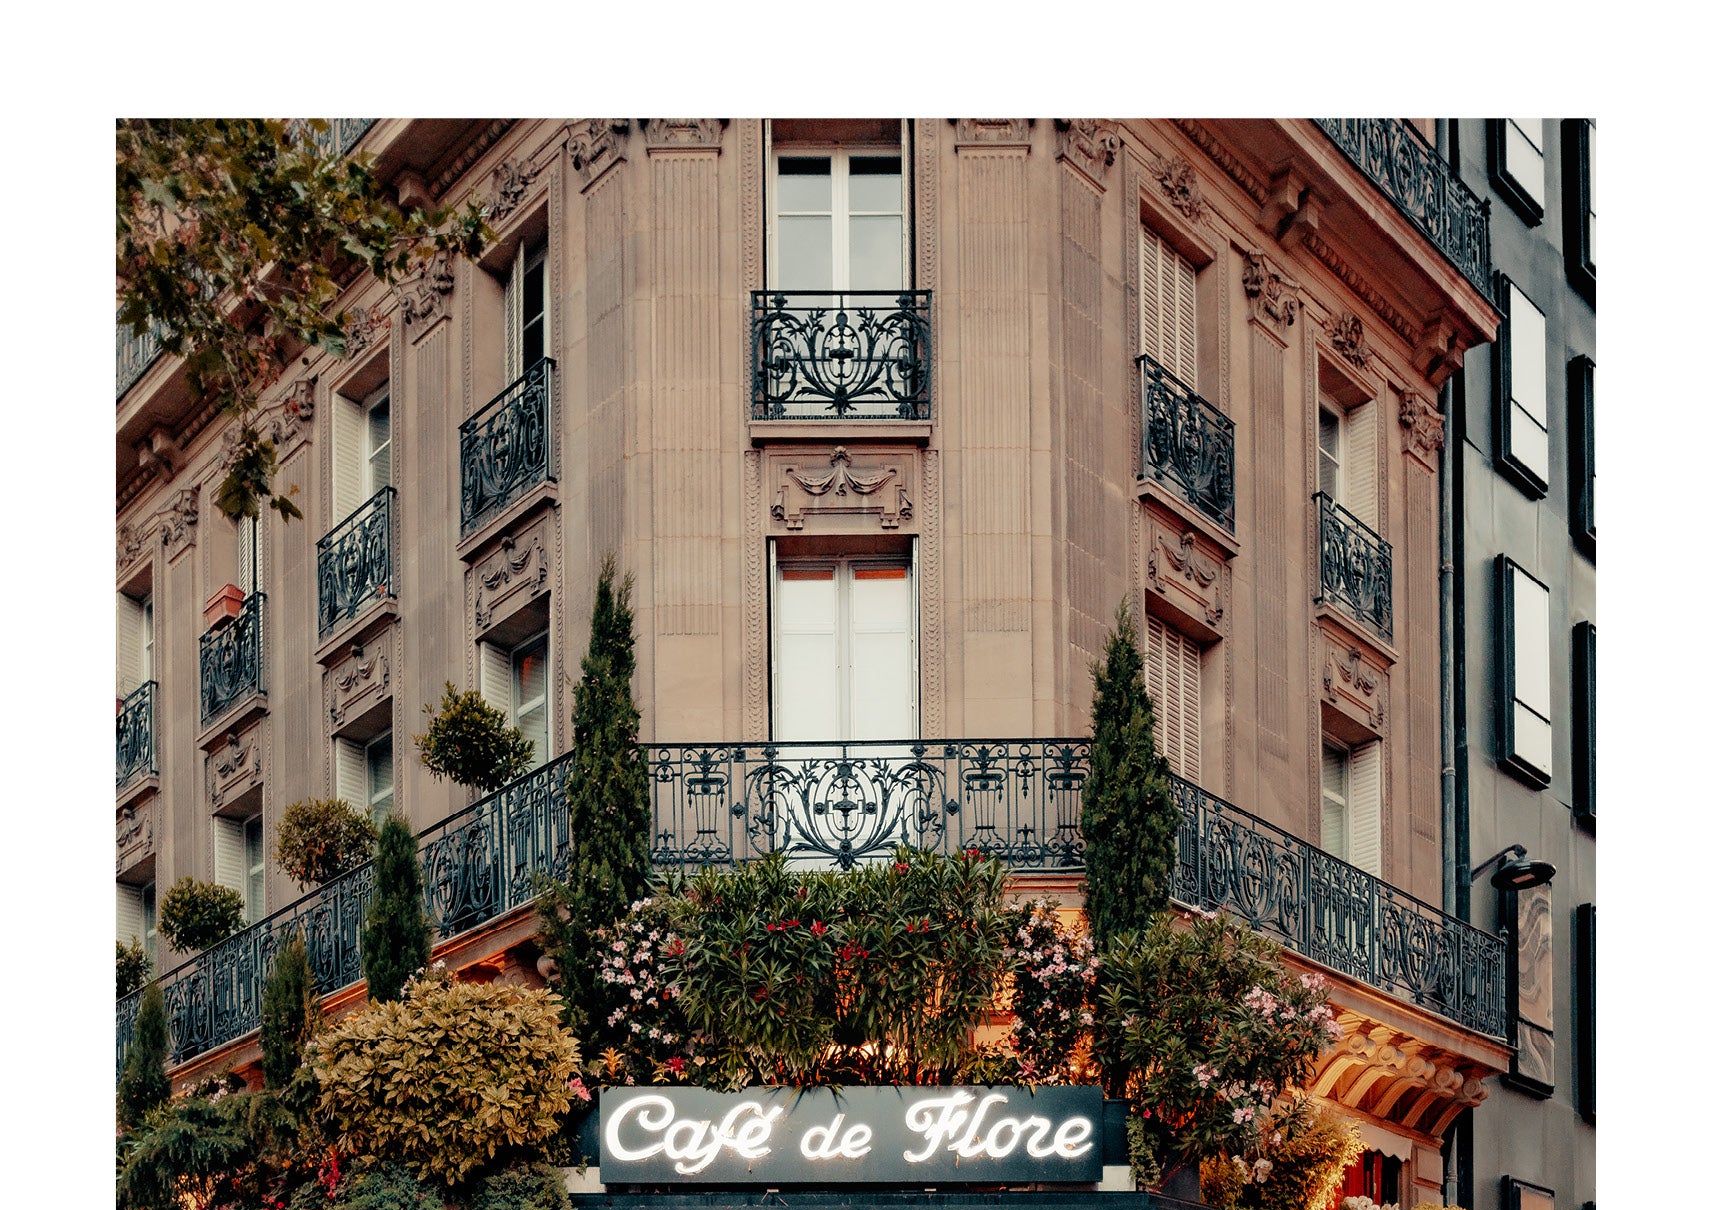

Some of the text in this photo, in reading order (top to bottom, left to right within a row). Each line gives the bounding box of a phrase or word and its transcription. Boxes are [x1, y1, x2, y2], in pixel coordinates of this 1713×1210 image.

[604, 1090, 1094, 1175] Café de Flore
